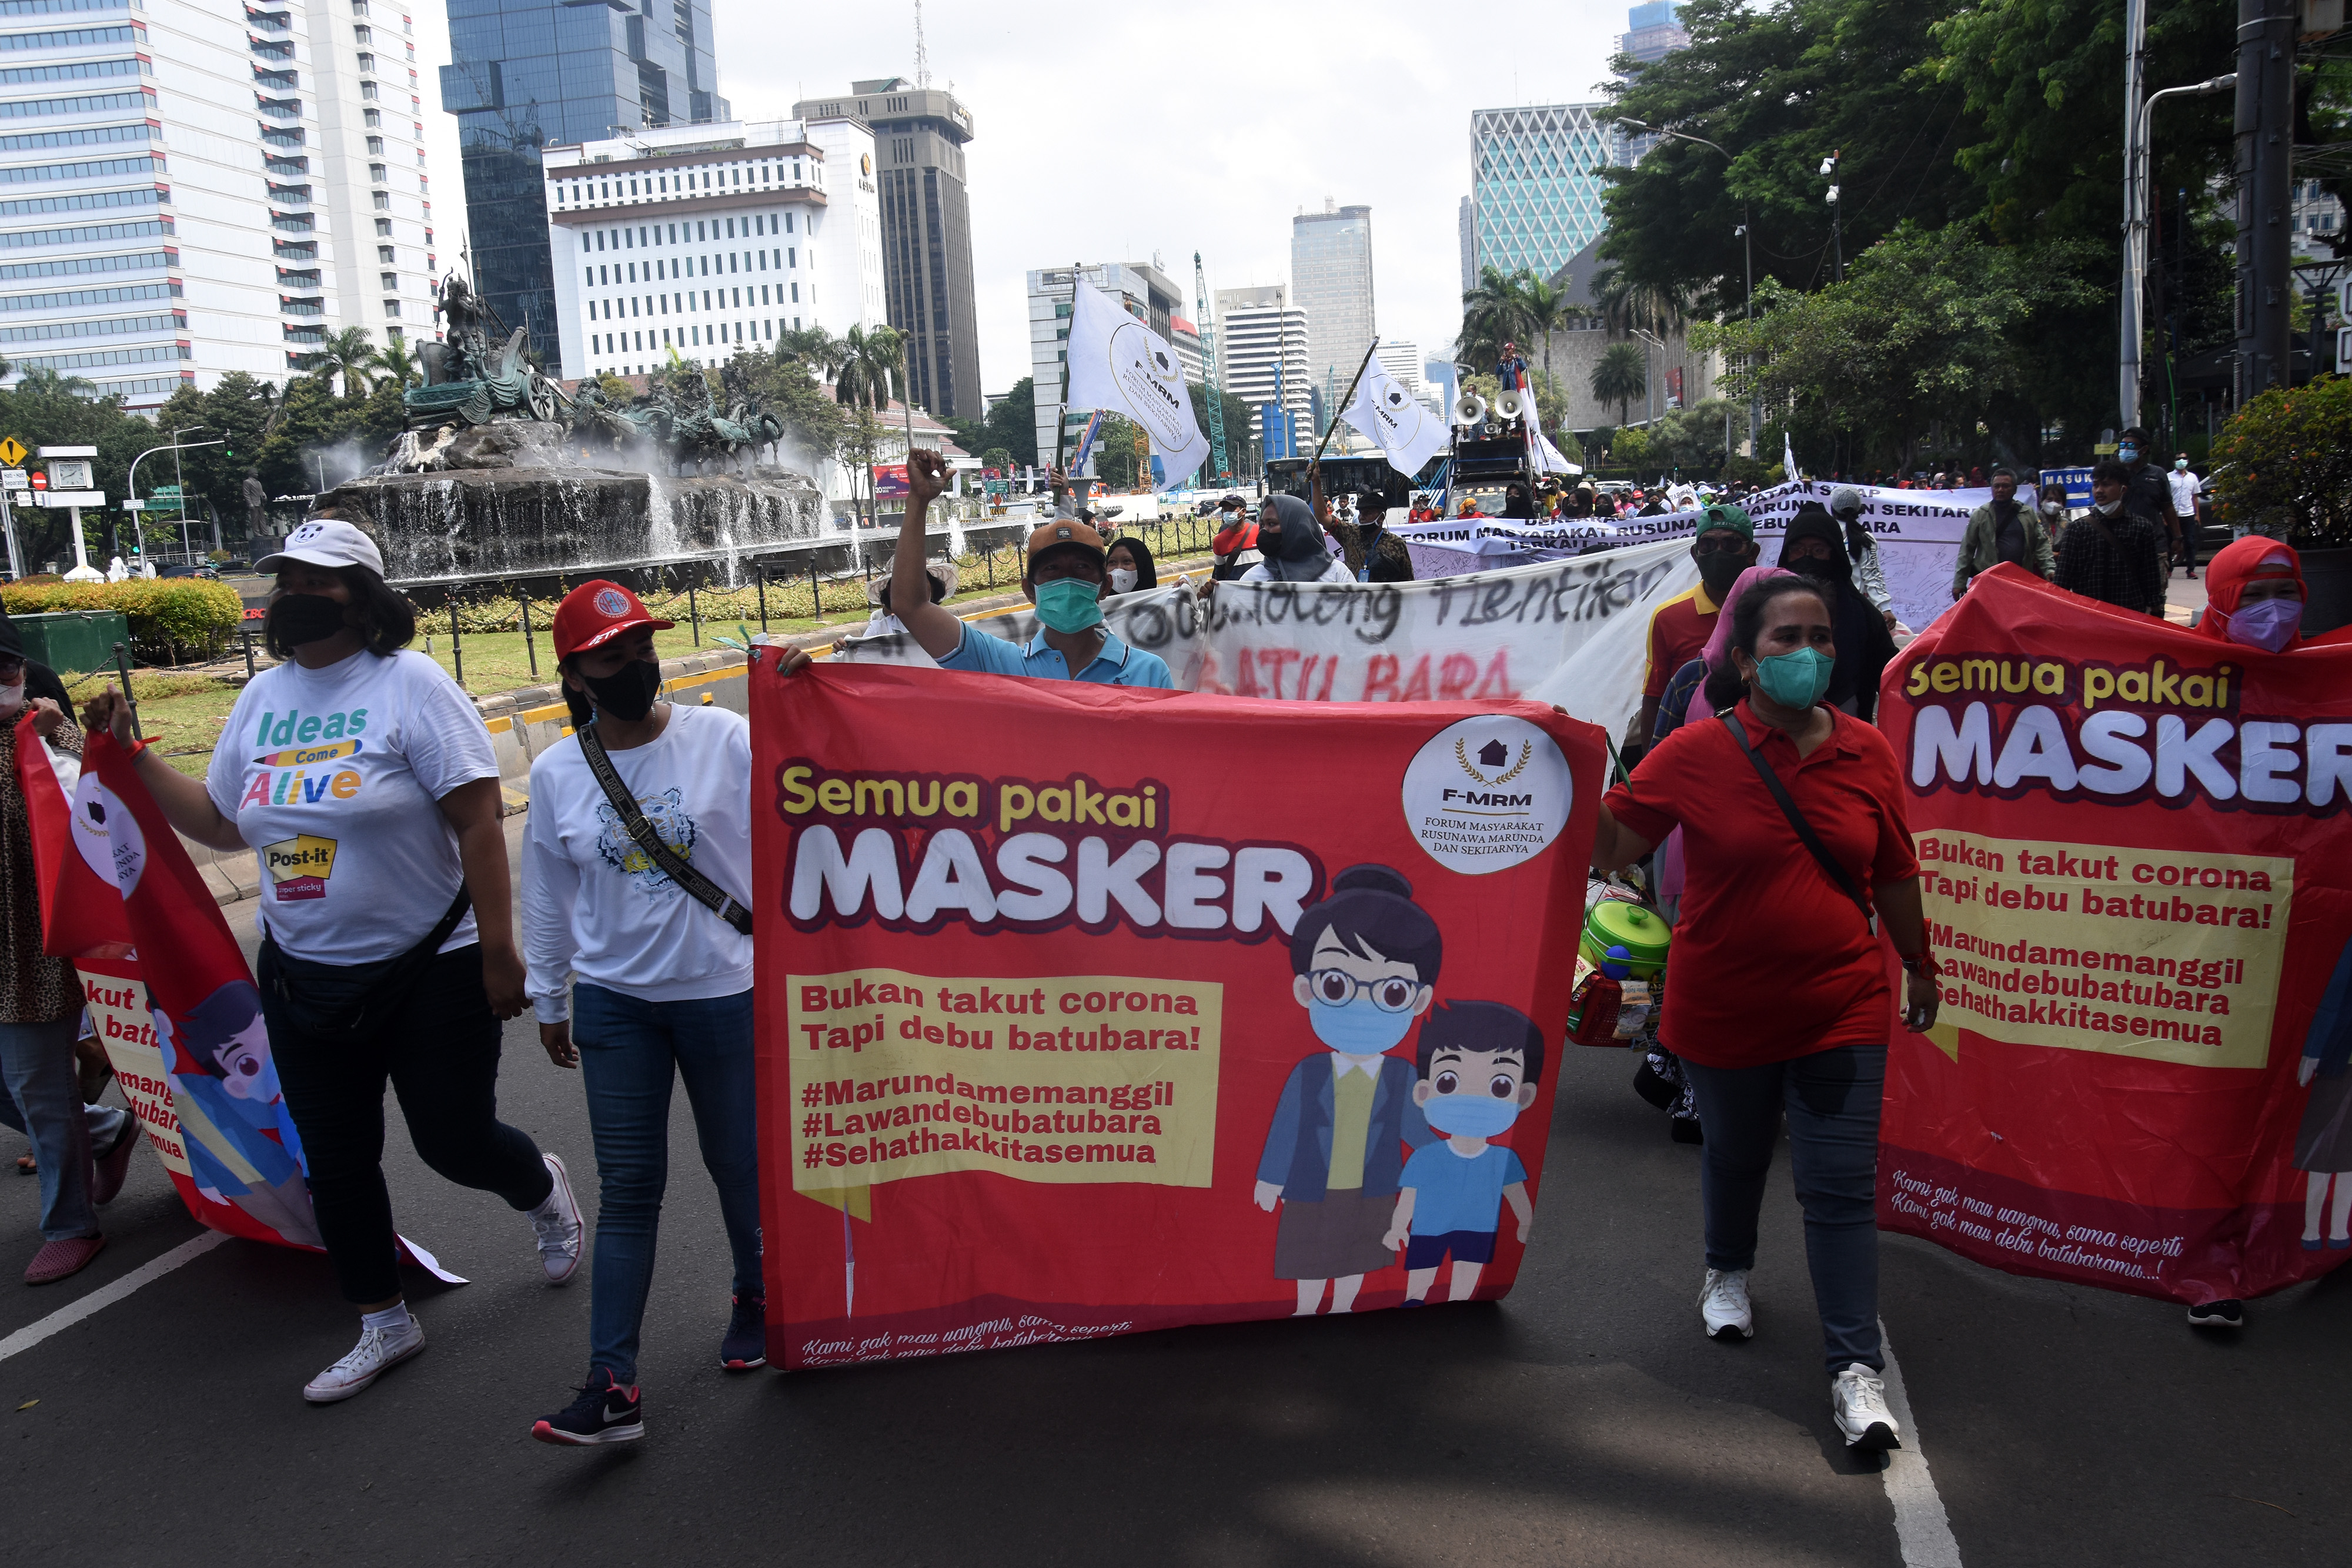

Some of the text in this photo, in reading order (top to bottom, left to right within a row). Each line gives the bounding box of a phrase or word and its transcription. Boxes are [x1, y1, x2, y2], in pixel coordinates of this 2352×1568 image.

[1128, 386, 1143, 401] DAN
[1135, 360, 1180, 409] F-MRM
[2046, 474, 2092, 485] MASUK
[1402, 530, 1469, 543] FORUM
[1476, 527, 1609, 539] MASYARAKAT
[1617, 519, 1696, 537] RUSUNA
[1882, 504, 1971, 518] SEKITAR
[1753, 517, 1788, 530] EBU
[243, 609, 266, 620] CBC
[588, 628, 619, 646] BETA
[1362, 646, 1521, 702] BARA
[1906, 658, 2231, 708] Semua pakai
[256, 708, 368, 747] Ideas
[295, 748, 338, 764] Come
[1912, 701, 2352, 807] MASKER
[240, 770, 362, 810] Alive
[606, 777, 624, 802] DORIO
[783, 766, 1156, 833] Semua pakai
[1442, 788, 1532, 807] F-MRM
[1421, 830, 1544, 843] RUSUNAWA MARUNDA
[1425, 817, 1544, 831] FORUM MASYARAKAT
[658, 852, 681, 873] DORIO
[1433, 842, 1529, 855] DAN SEKITARNYA
[1919, 837, 2271, 892] Bukan takut corona
[297, 882, 322, 892] sticky
[690, 877, 723, 905] CHRISITA
[790, 824, 1312, 936] MASKER
[1919, 870, 2272, 929] Tapi debu batubara!
[88, 979, 135, 1011] kut
[801, 978, 1198, 1016] Bukan takut corona
[1935, 979, 2221, 1047] Sehathakkitasemua
[801, 1014, 1201, 1053] Tapi debu batubara!
[801, 1072, 1174, 1111] #Marundamemanggil
[802, 1100, 1162, 1138] #Lawandebubatubara
[803, 1128, 1156, 1169] #Sehathakkitasemua
[1892, 1192, 1929, 1219] Kami
[1930, 1210, 1957, 1230] gak
[1959, 1219, 1992, 1242] mau
[1995, 1228, 2034, 1255] debu
[1893, 1170, 2184, 1258] Kami gak mau uangmu, sama seperti
[802, 1315, 1132, 1356] Kami gak mau uangmu, sama seperti
[802, 1355, 854, 1366] Kami
[859, 1349, 892, 1363] gak
[896, 1348, 937, 1359] mau
[941, 1340, 985, 1354] debu
